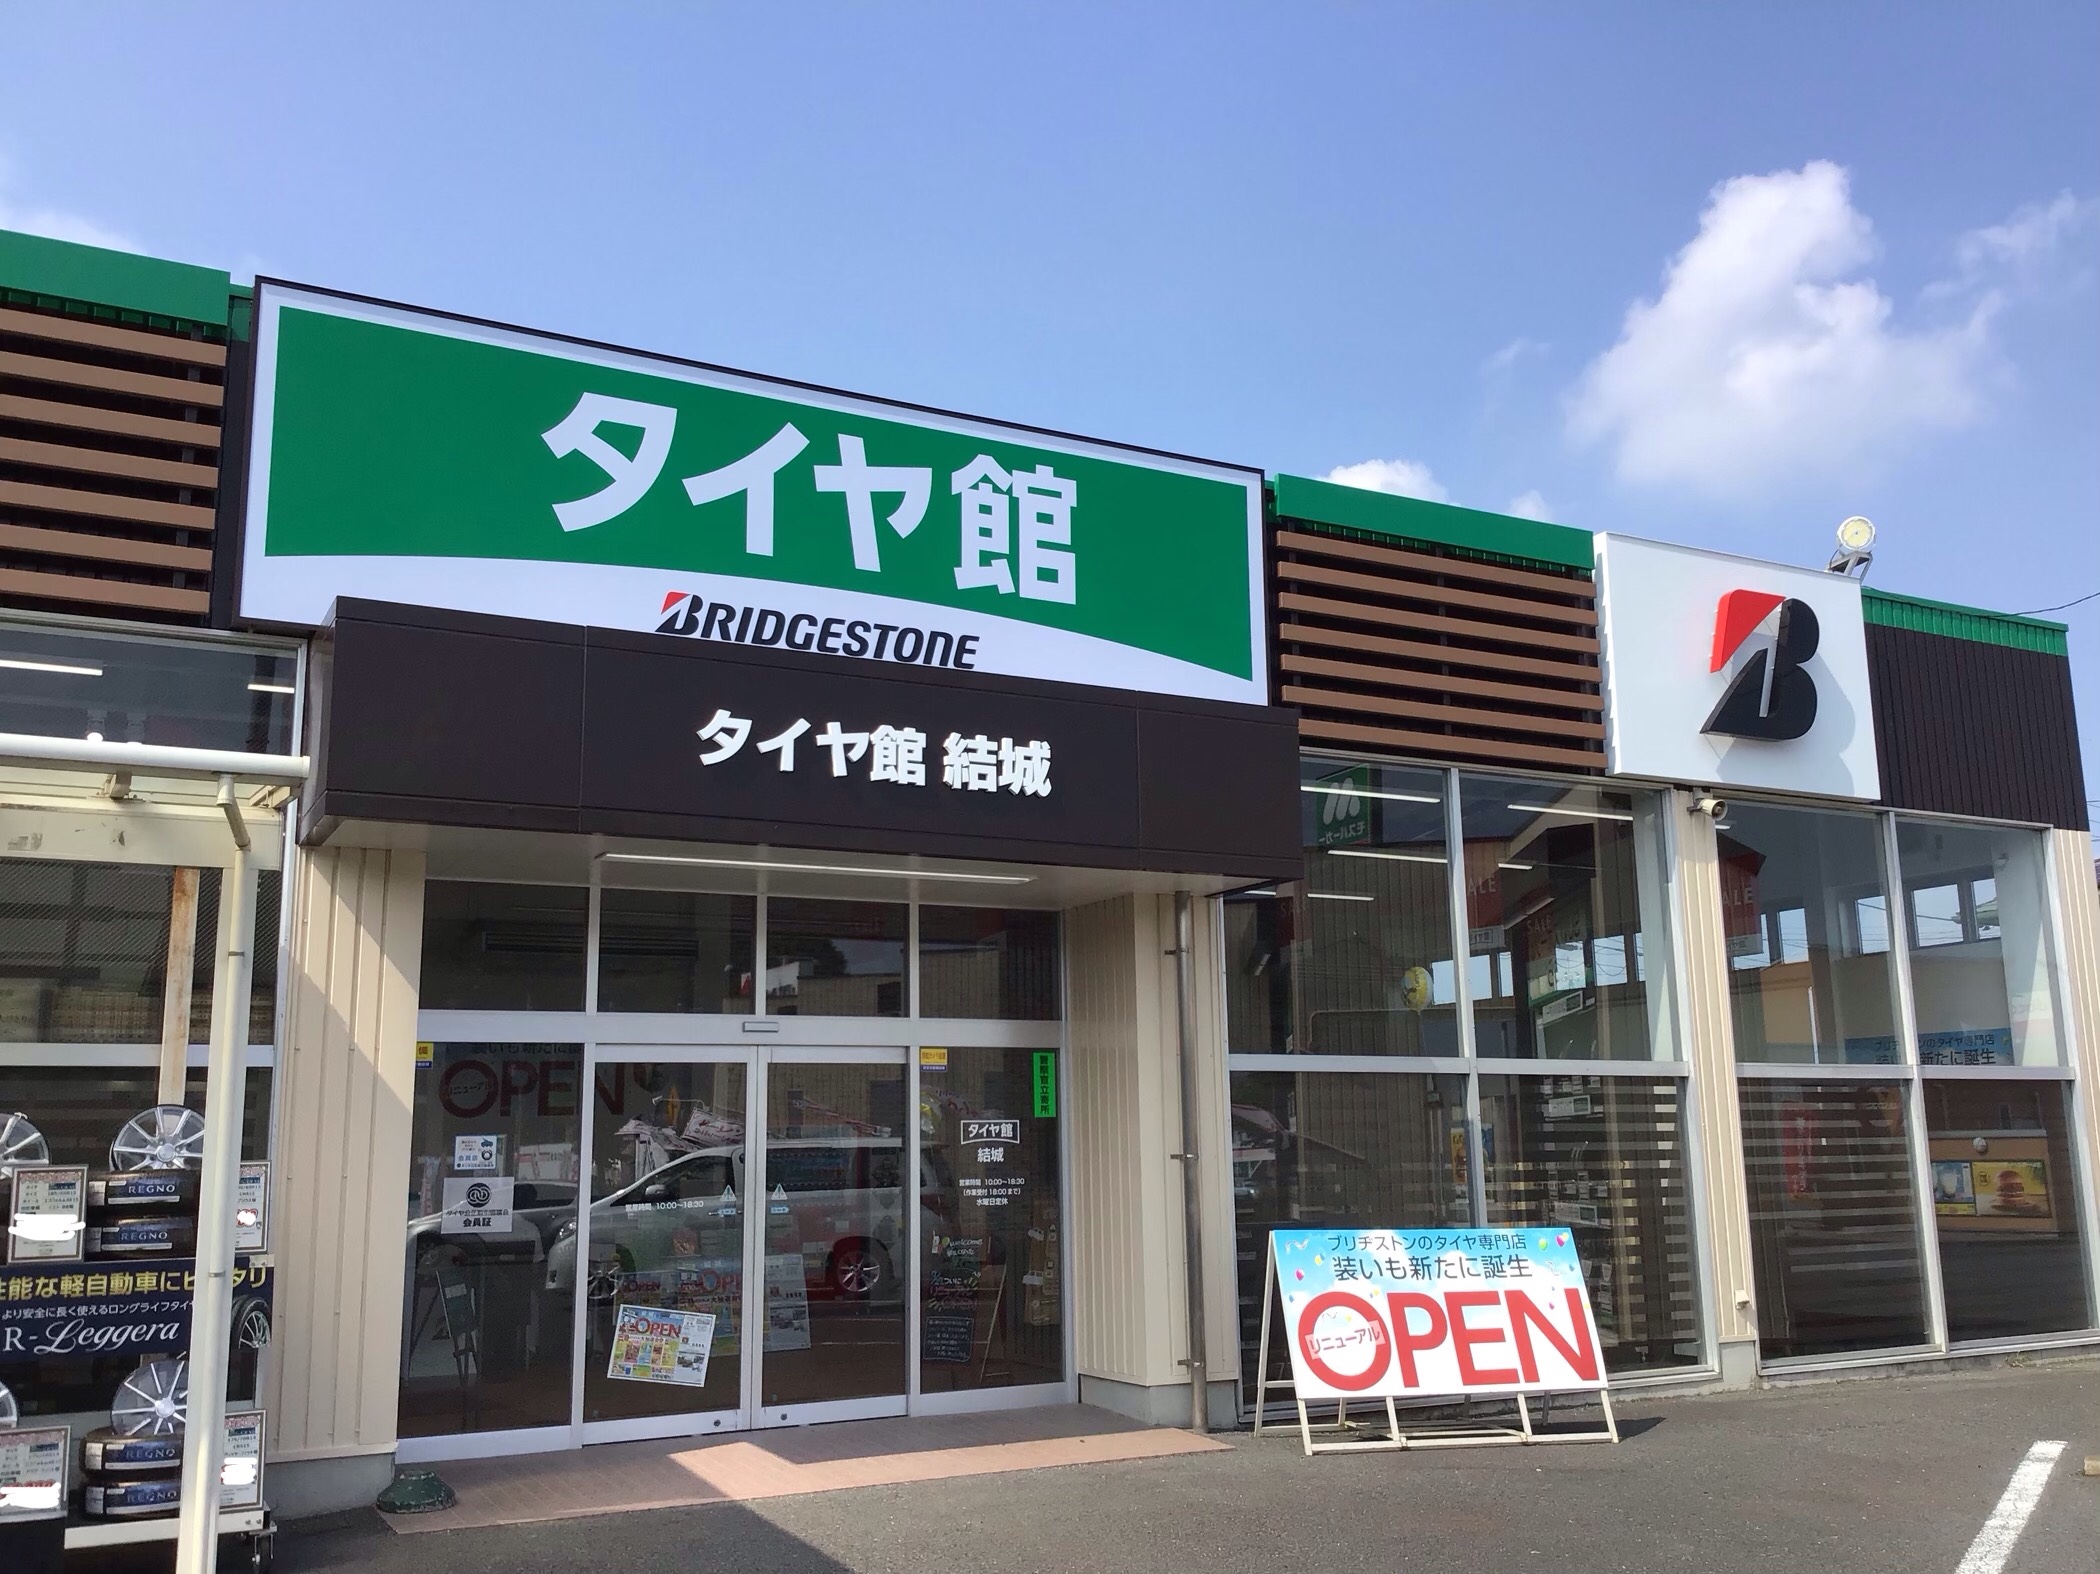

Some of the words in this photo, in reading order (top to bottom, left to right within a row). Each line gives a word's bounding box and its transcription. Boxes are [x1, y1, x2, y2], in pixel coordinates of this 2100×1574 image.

[541, 391, 1077, 605] タイヤ館
[655, 591, 980, 670] BRIDGESTONE
[697, 709, 926, 787] タイヤ館
[943, 732, 1052, 798] 結城
[1468, 876, 1496, 896] ALE
[1723, 887, 1754, 905] ALE
[968, 1123, 1013, 1138] タイヤ館
[977, 1148, 1004, 1163] 結城
[128, 1184, 176, 1194] REGNO
[463, 1217, 492, 1228] 会員証
[120, 1231, 168, 1241] REGNO
[1327, 1234, 1527, 1251] ブリヂストンのタイヤ専門店
[1332, 1255, 1533, 1281] 装いも新たに誕生
[1298, 1288, 1601, 1391] OPEN
[1308, 1320, 1381, 1354] リニューアル
[126, 1448, 176, 1459] REGNO
[127, 1490, 177, 1502] REGNO
